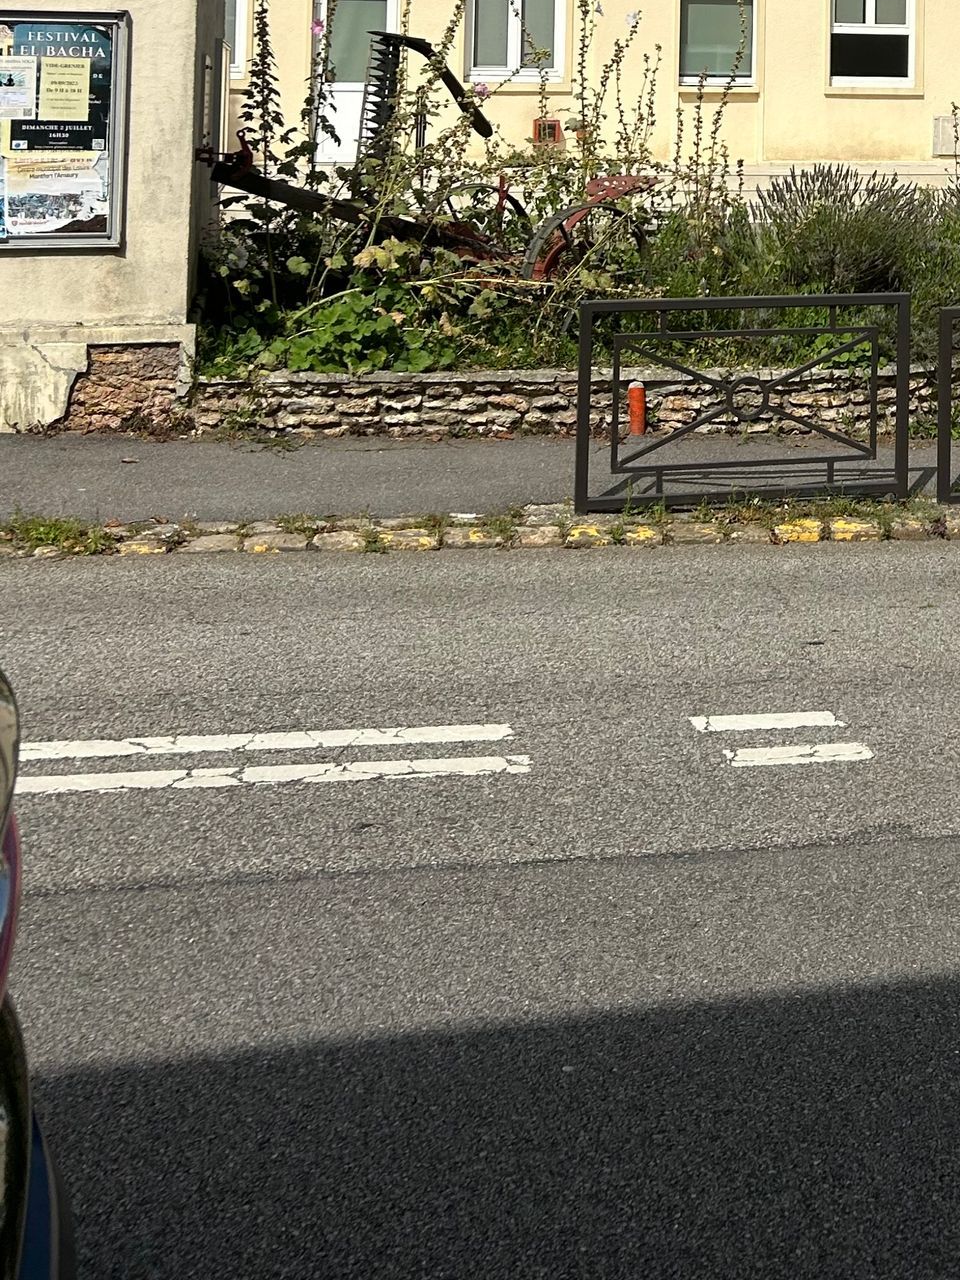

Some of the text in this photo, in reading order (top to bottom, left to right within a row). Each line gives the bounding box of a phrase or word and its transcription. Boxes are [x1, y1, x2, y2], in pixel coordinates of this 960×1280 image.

[28, 31, 99, 43] FESTIVAL
[20, 45, 39, 56] EL
[46, 45, 106, 58] BACHA
